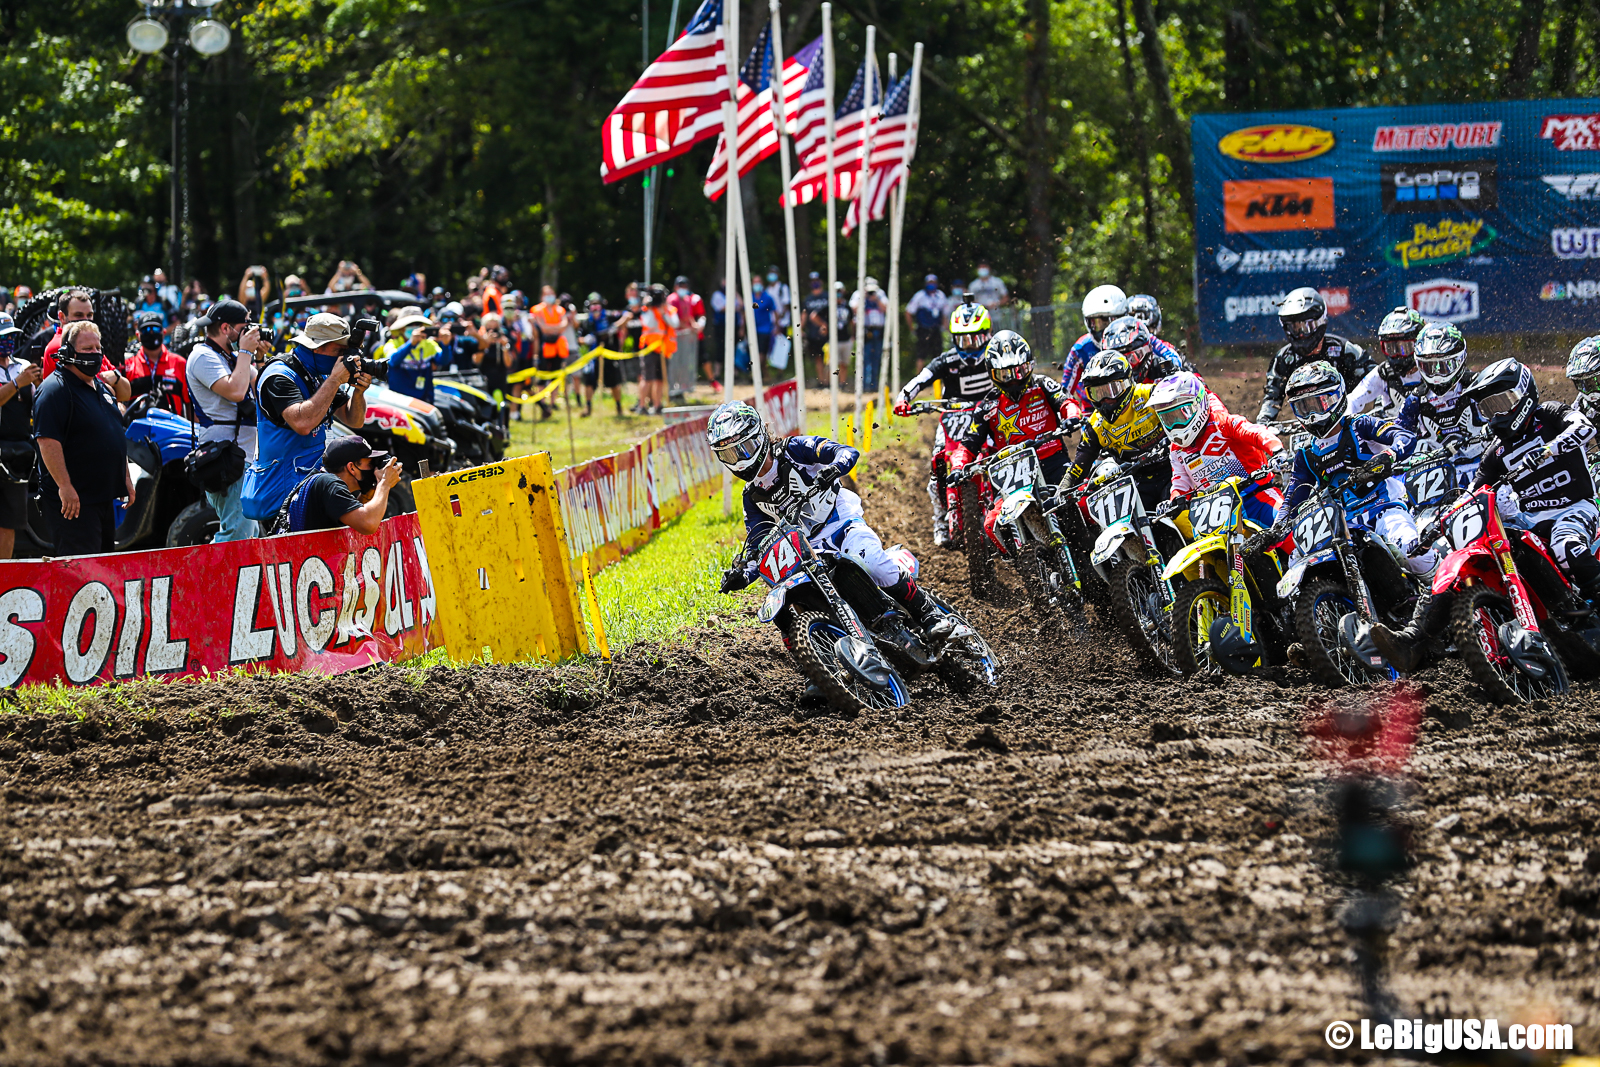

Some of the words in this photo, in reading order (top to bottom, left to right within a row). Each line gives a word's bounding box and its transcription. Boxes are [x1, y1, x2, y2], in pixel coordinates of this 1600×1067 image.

[1394, 169, 1480, 187] GoPro
[1245, 194, 1314, 219] KTM
[1413, 219, 1484, 244] Battery
[1241, 247, 1345, 265] DUNLOP
[1395, 238, 1472, 269] Tender
[1417, 290, 1472, 315] 100%
[1566, 280, 1600, 299] NB
[1020, 415, 1031, 427] FLY
[1191, 412, 1208, 432] split
[1511, 398, 1533, 431] GEICO
[446, 466, 504, 487] ACERBIS
[997, 456, 1033, 495] 24
[1192, 456, 1230, 482] SUZUKI
[1415, 465, 1429, 475] LUCAS
[1412, 467, 1445, 504] 12
[1095, 485, 1132, 528] 117
[1195, 495, 1232, 533] 26
[1525, 496, 1571, 510] HONDA
[1297, 506, 1334, 553] 32
[1452, 503, 1485, 551] 6
[764, 534, 798, 583] 14
[229, 546, 382, 666] LUCAS
[62, 575, 189, 686] OIL
